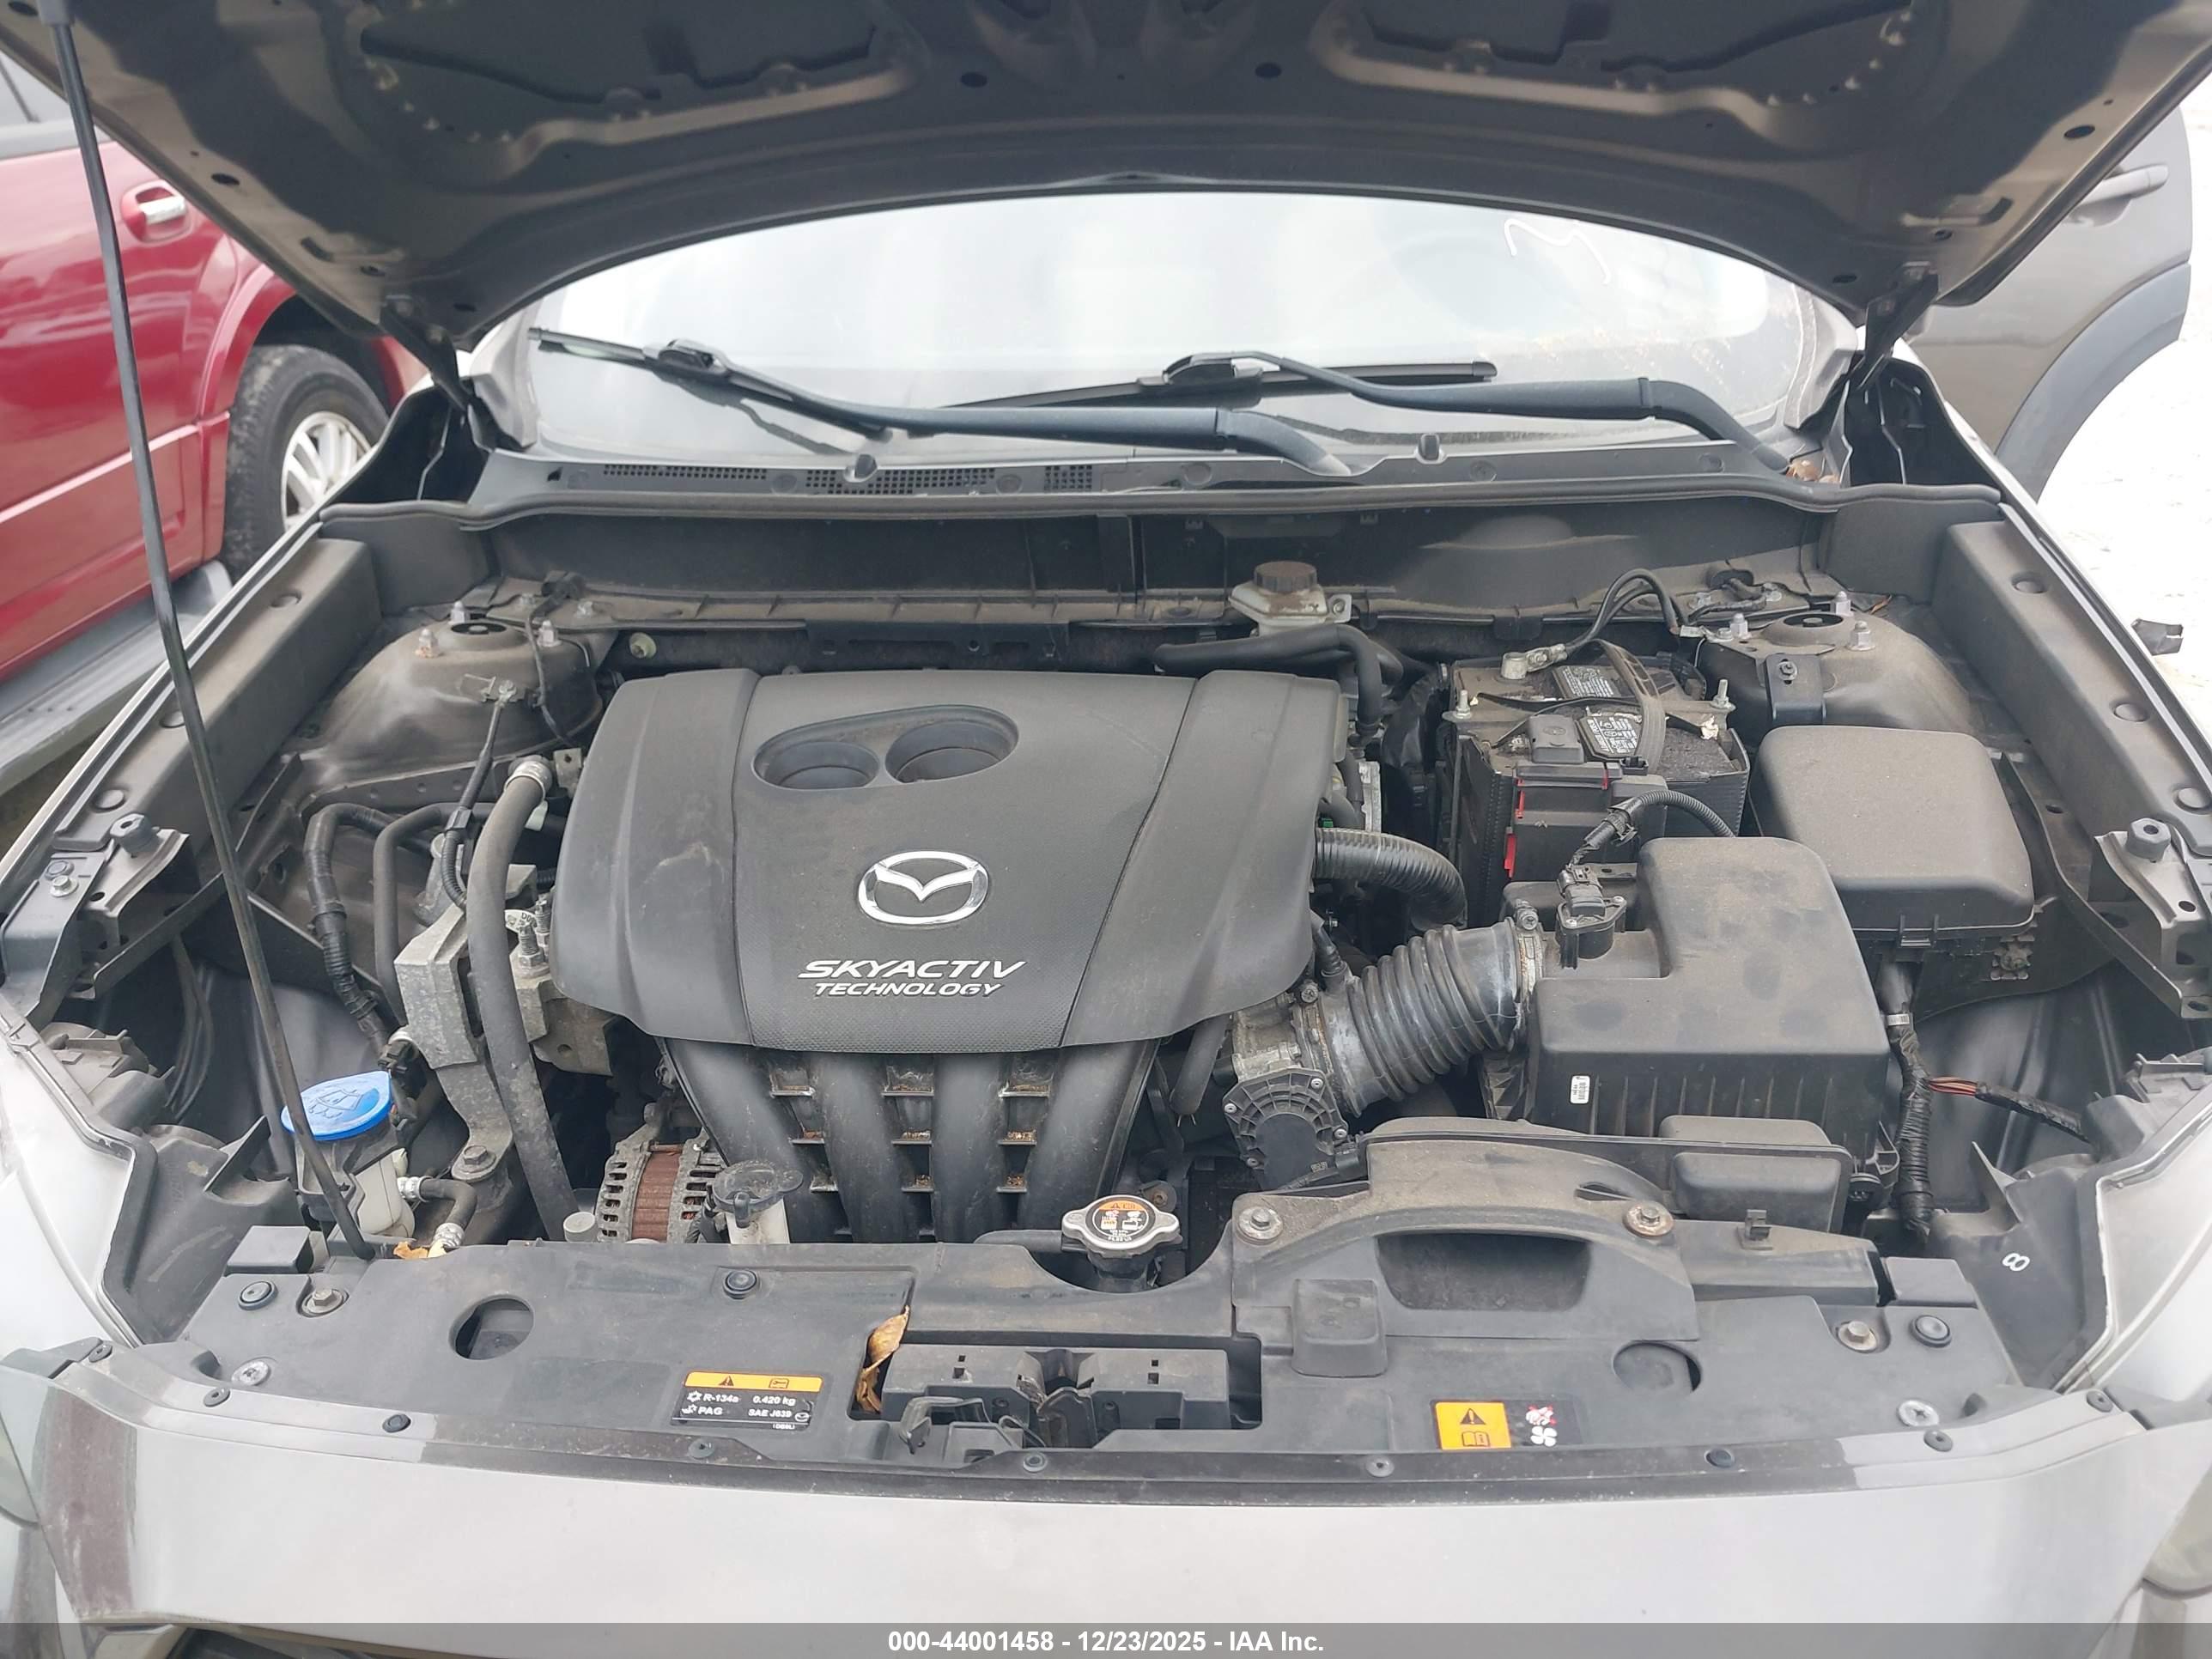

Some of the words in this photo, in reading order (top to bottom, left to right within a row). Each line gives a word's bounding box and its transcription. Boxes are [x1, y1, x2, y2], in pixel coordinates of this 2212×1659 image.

[797, 959, 1027, 979] SKYACTIV
[814, 982, 1003, 997] TECHNOLOGY
[702, 1393, 739, 1403] R-134a
[752, 1395, 781, 1405] 0.420
[782, 1396, 797, 1407] kg
[697, 1406, 723, 1416] PAG
[748, 1408, 769, 1418] SAE
[769, 1409, 792, 1419] J639
